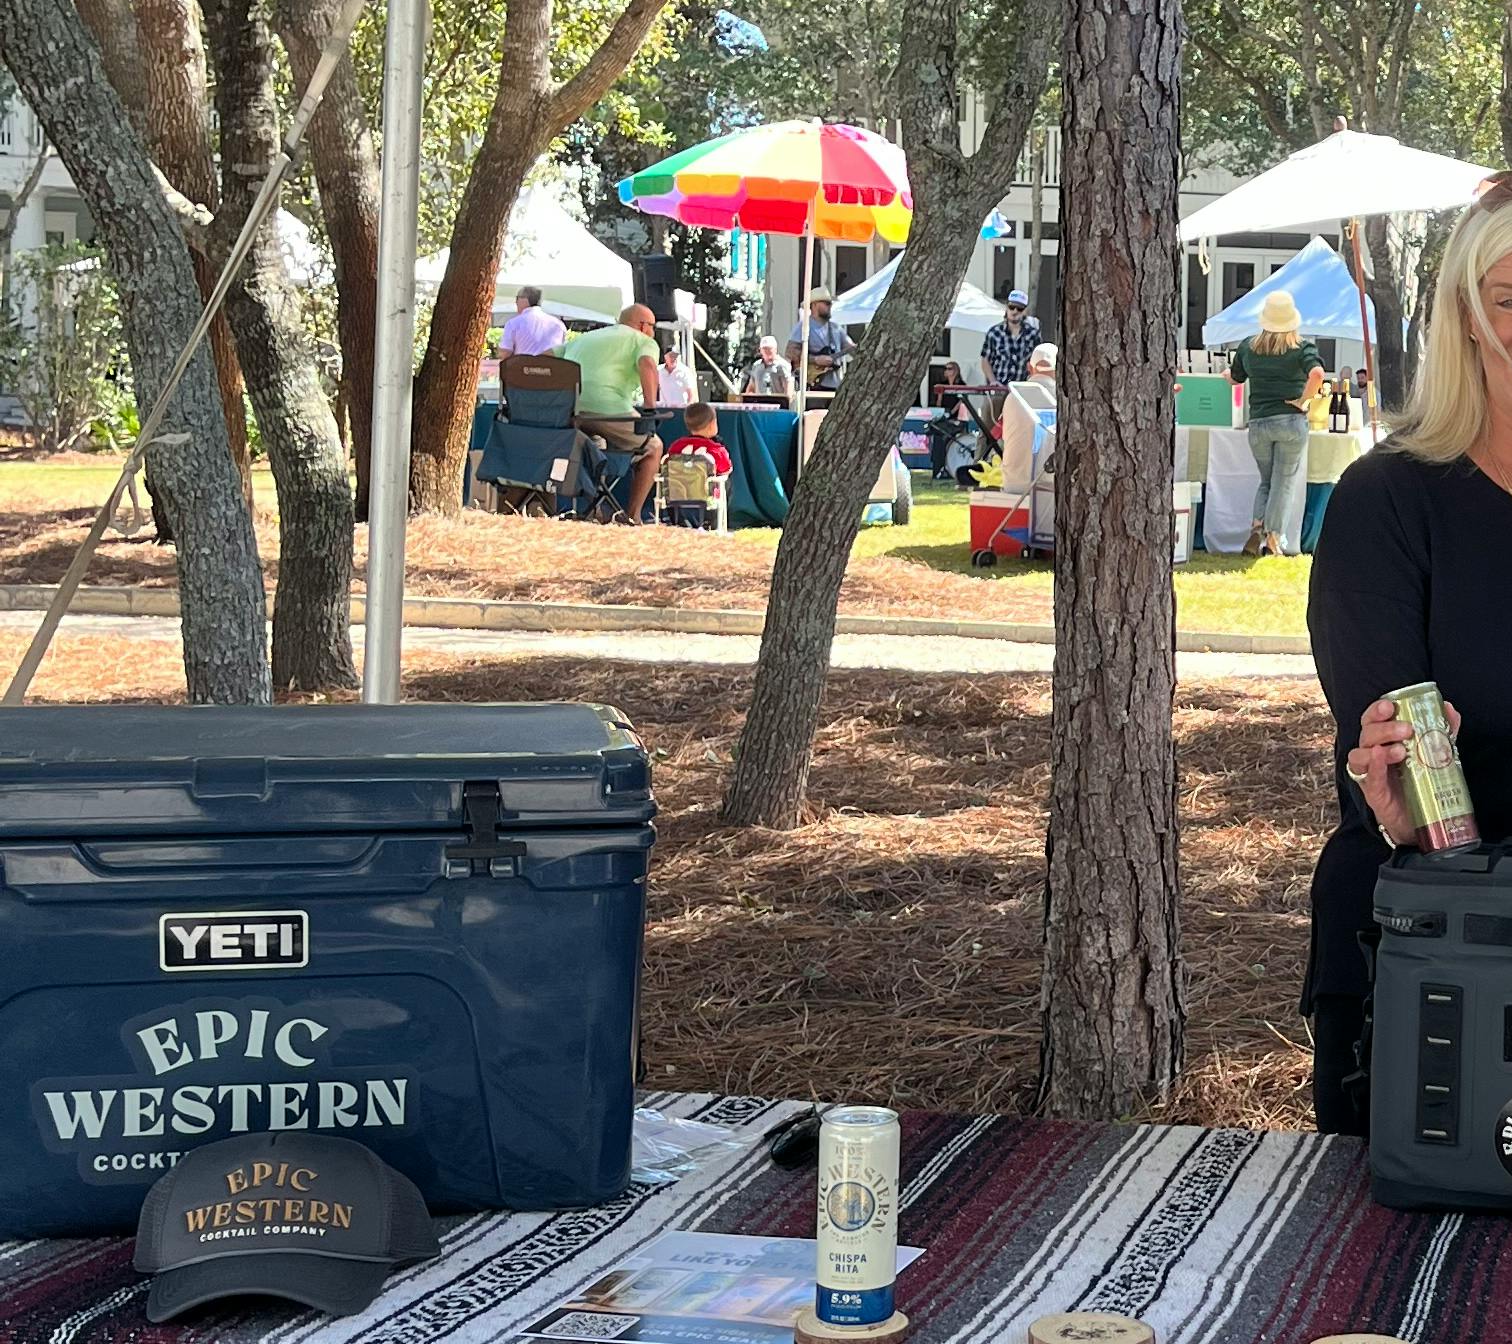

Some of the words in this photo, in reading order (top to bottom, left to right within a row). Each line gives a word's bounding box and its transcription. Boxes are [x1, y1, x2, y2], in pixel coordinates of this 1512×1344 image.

[169, 923, 294, 960] YETI
[136, 1010, 329, 1075] EPIC
[43, 1079, 408, 1139] WESTERN
[93, 1152, 190, 1172] COCKT
[226, 1162, 318, 1195] EPIC
[185, 1198, 353, 1233] WESTERN
[199, 1227, 257, 1242] COCKTAIL
[263, 1225, 327, 1237] COMPANY
[829, 1251, 868, 1264] CHISPA
[835, 1262, 860, 1274] RITA
[831, 1292, 863, 1305] 5.9%
[638, 1328, 672, 1337] FOR
[675, 1331, 715, 1340] EPIC
